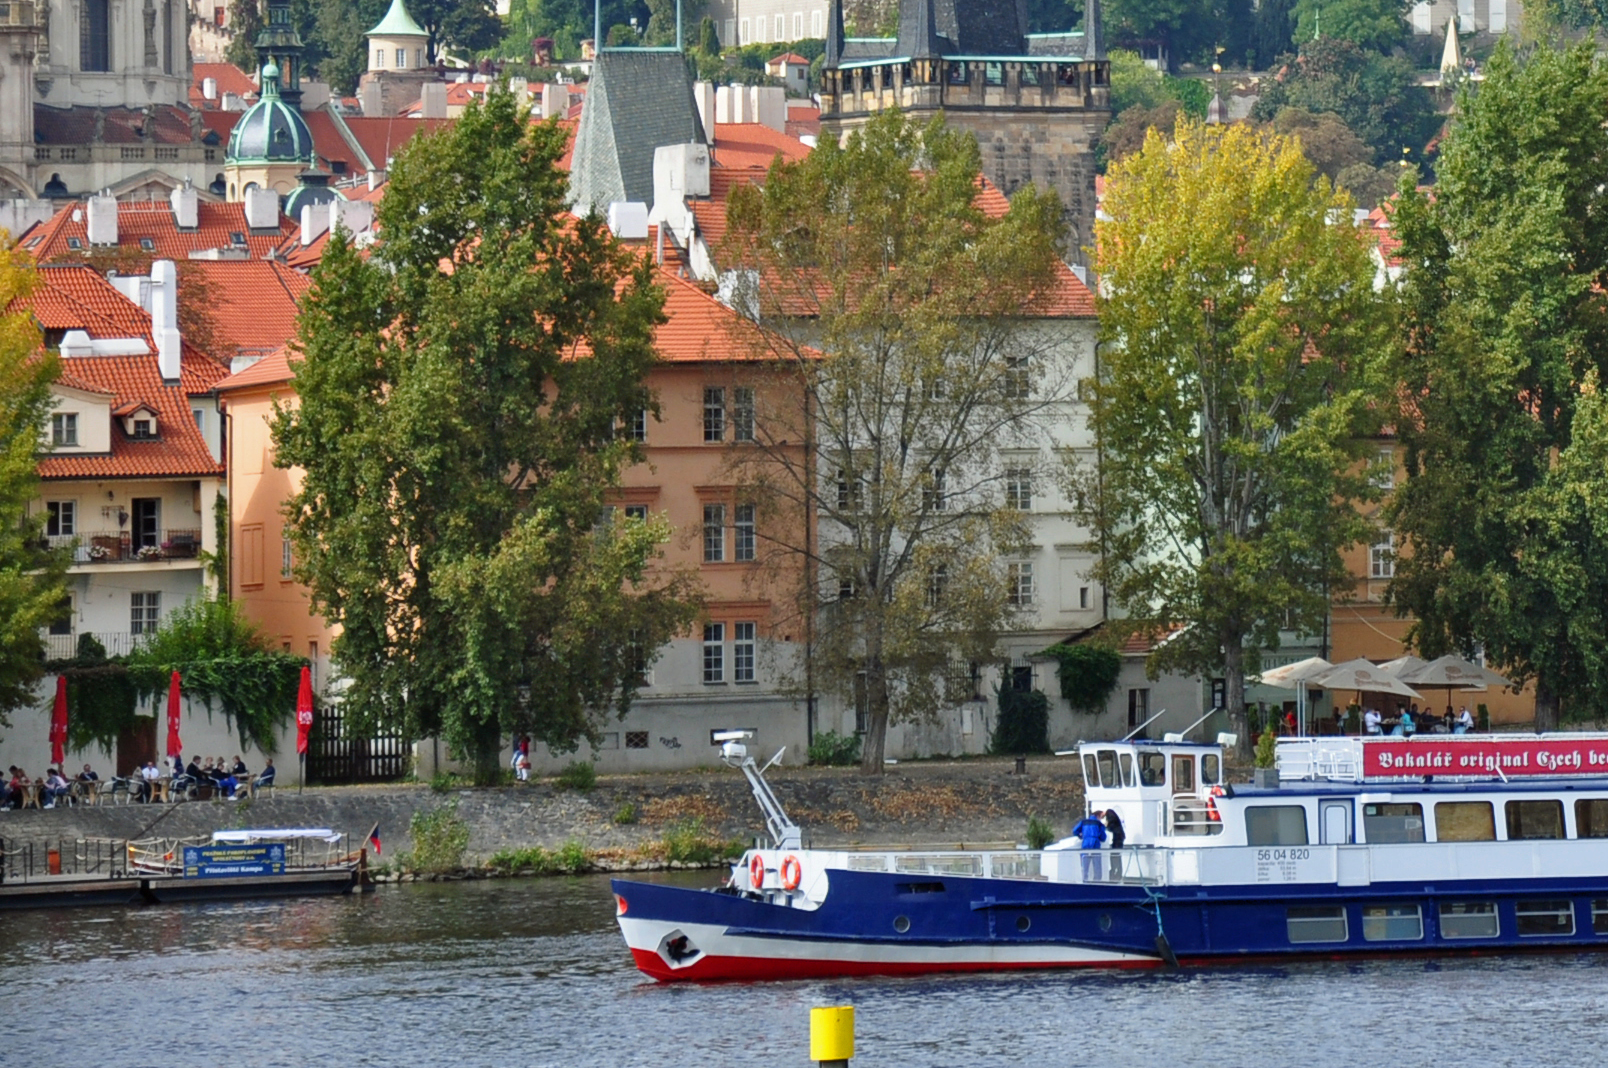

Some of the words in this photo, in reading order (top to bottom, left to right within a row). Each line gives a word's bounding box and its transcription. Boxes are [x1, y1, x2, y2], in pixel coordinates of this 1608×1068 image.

[1378, 750, 1453, 768] Bakalář
[1459, 751, 1529, 771] original
[1536, 749, 1582, 770] Czech
[1257, 850, 1271, 861] 56
[1273, 849, 1287, 860] 04
[1290, 849, 1310, 860] 820
